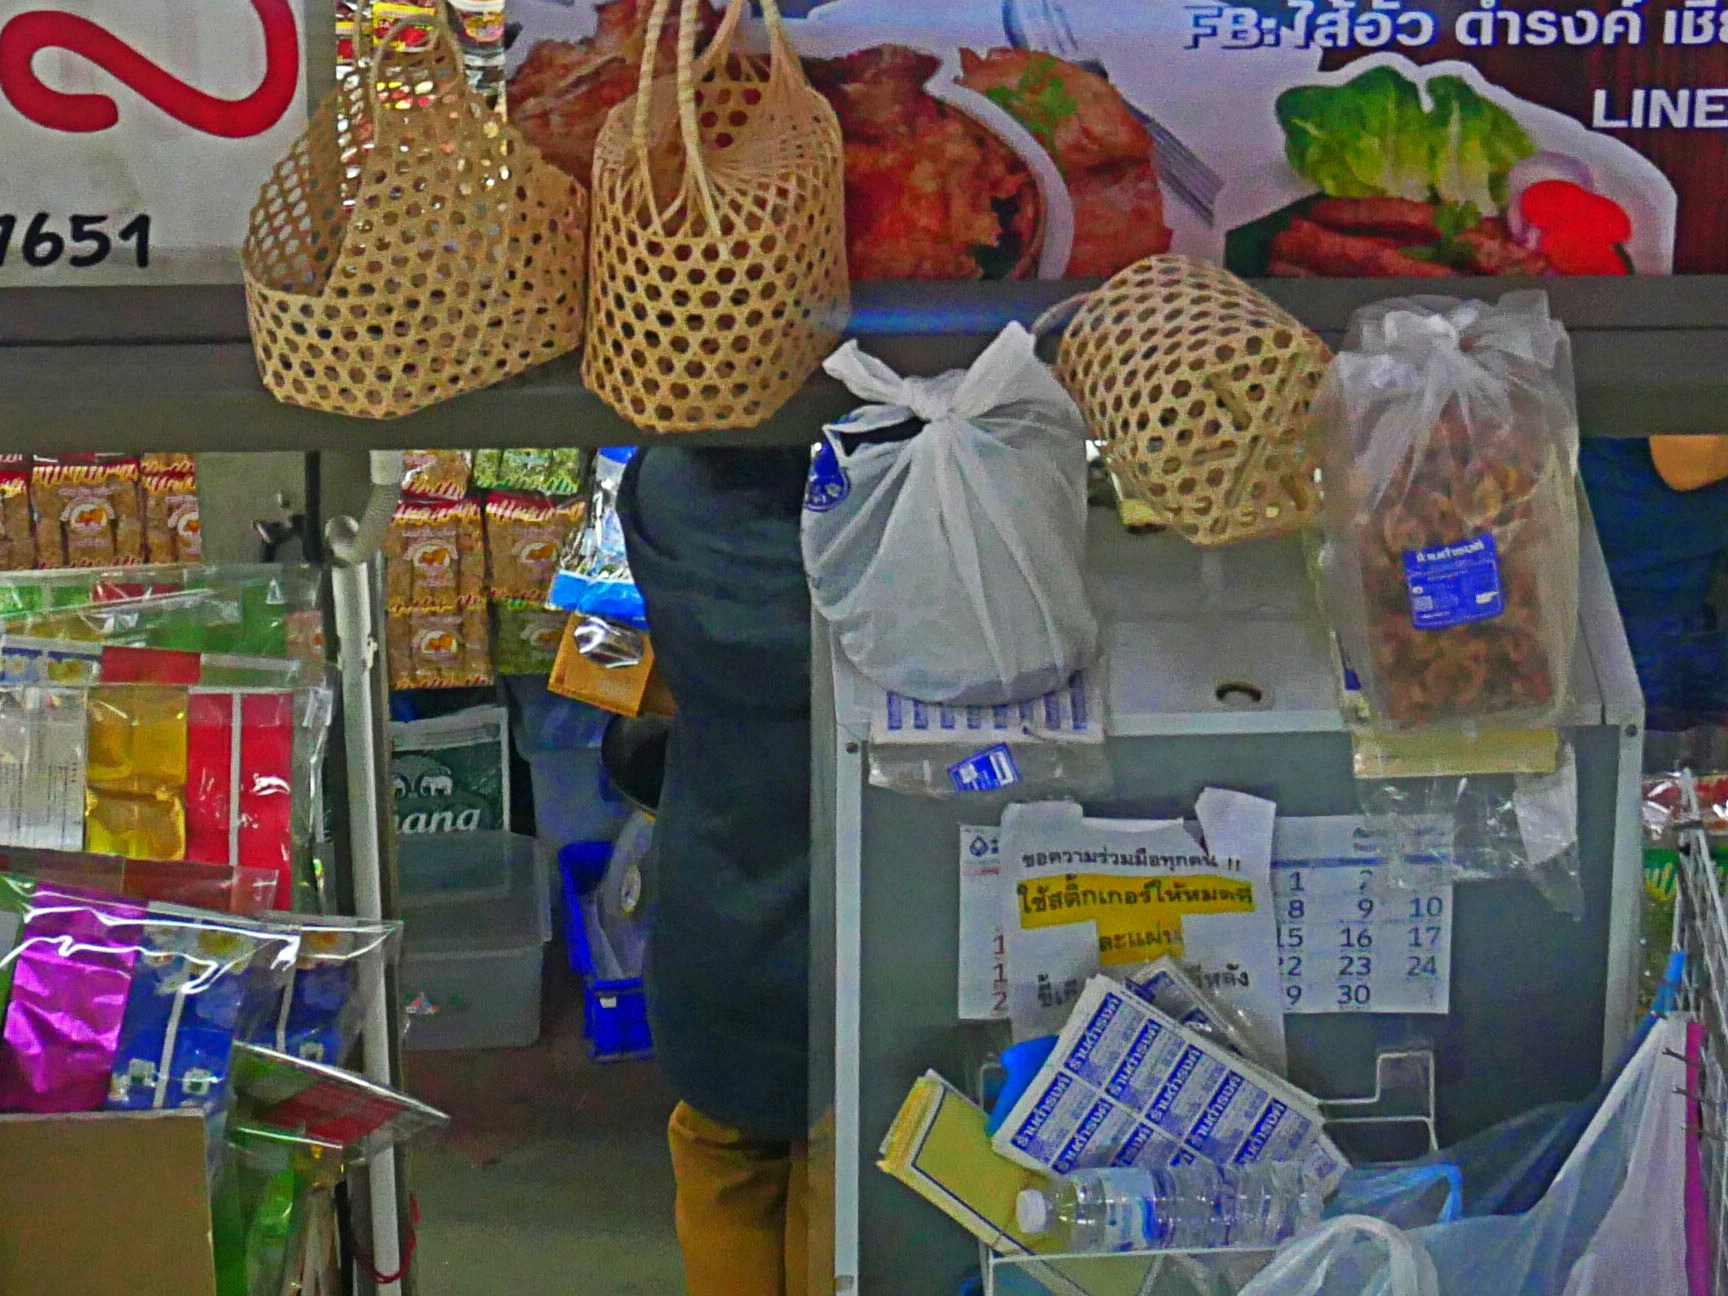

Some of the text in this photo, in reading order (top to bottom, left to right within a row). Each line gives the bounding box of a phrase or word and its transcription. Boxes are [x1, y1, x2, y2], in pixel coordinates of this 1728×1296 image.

[1287, 897, 1443, 920] 8 9 10
[1339, 928, 1373, 949] 16
[1408, 926, 1440, 948] 17
[1339, 956, 1371, 977] 23
[1406, 955, 1437, 975] 24
[1337, 984, 1371, 1006] 30
